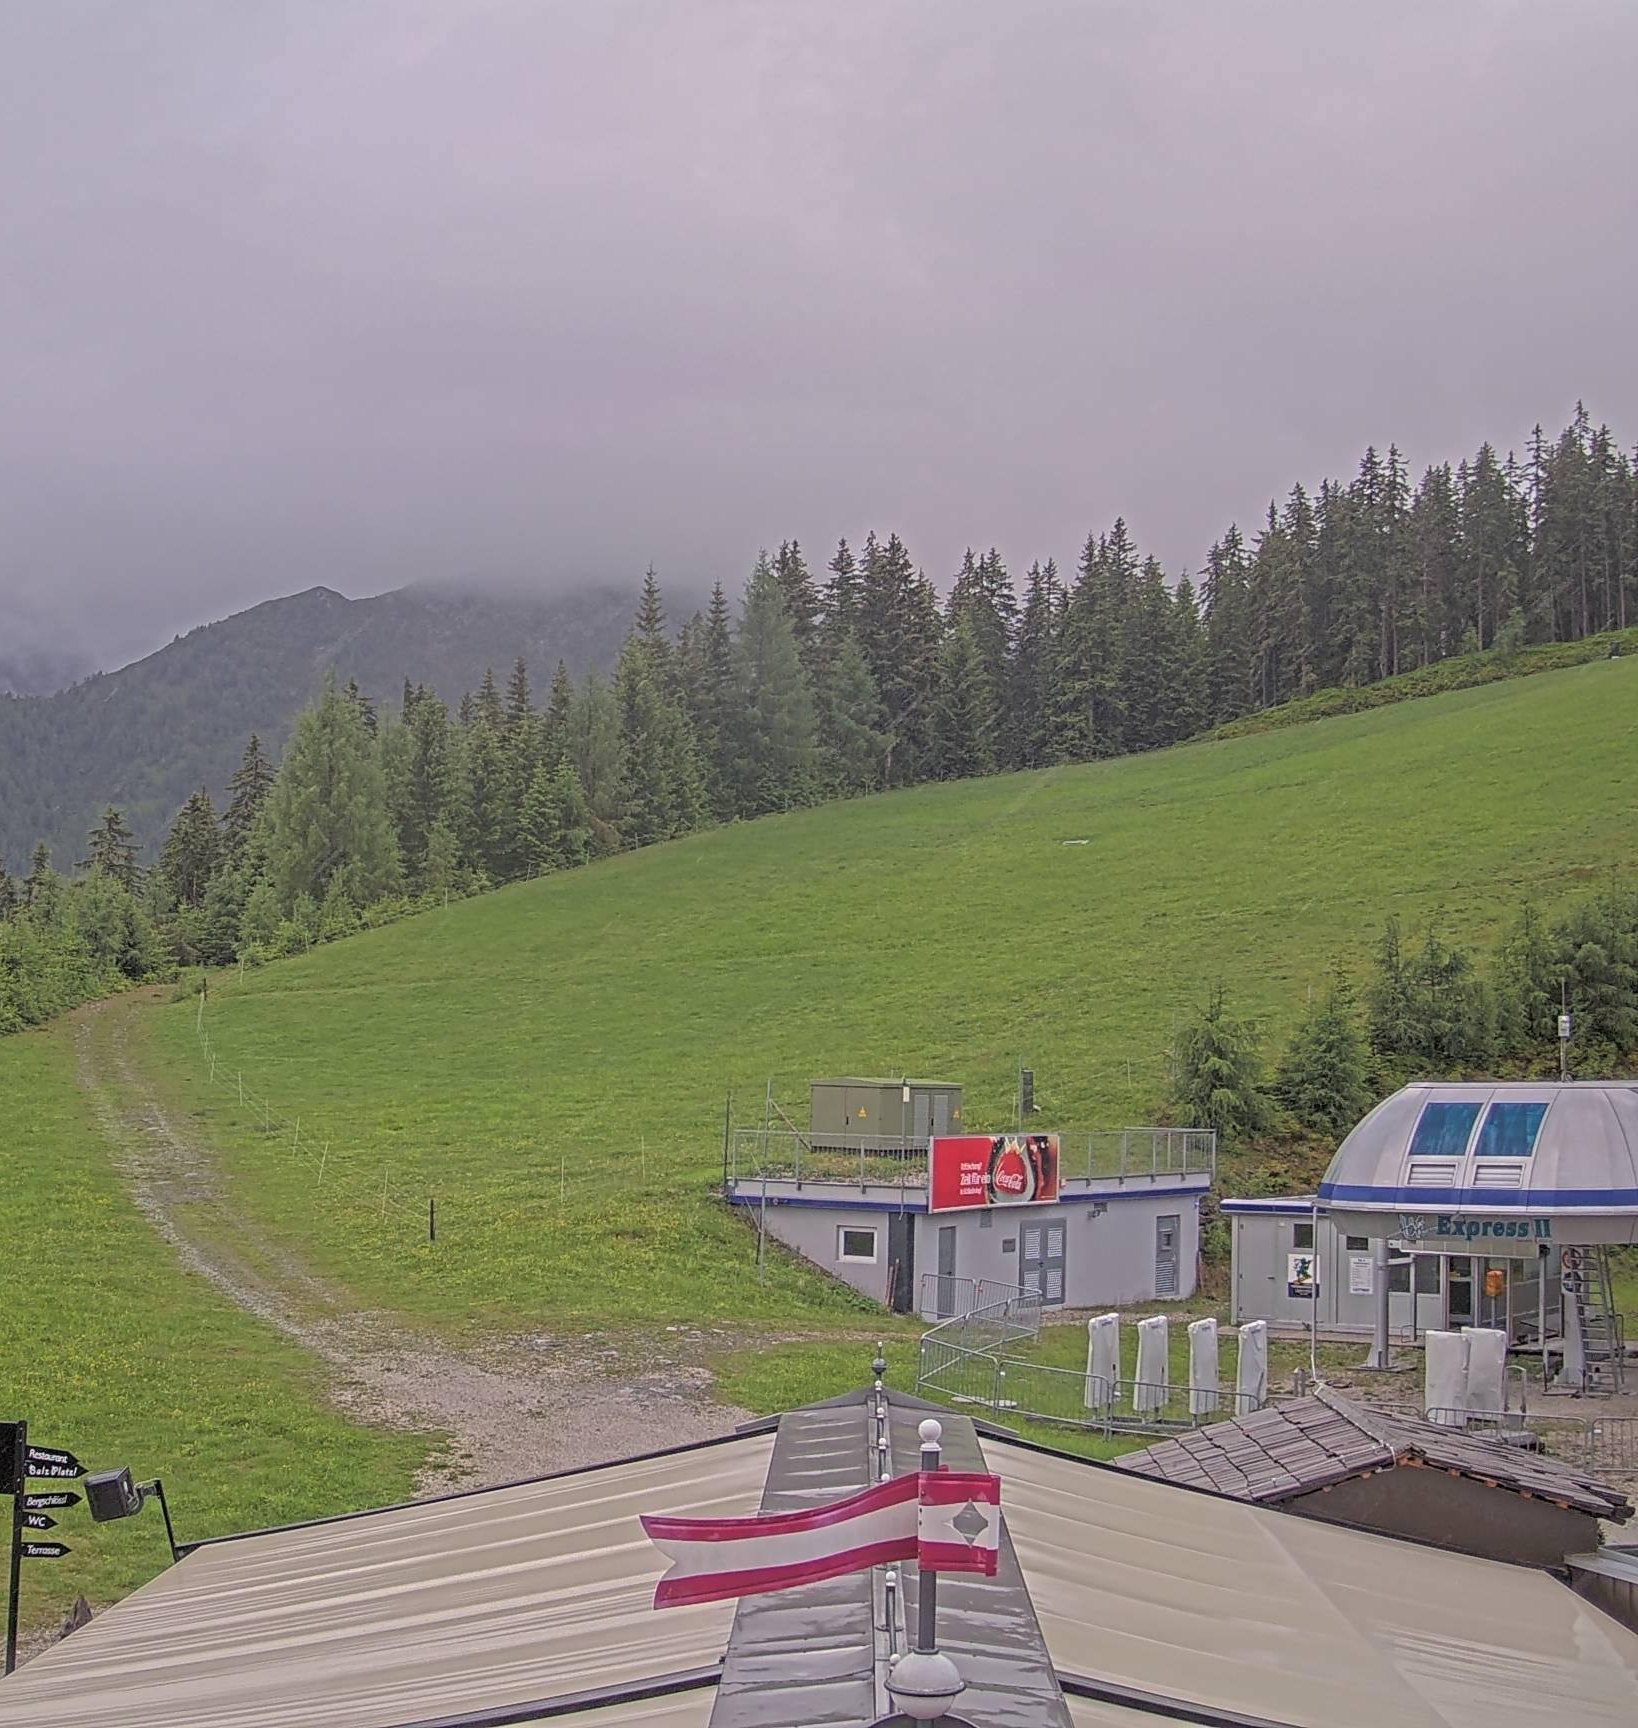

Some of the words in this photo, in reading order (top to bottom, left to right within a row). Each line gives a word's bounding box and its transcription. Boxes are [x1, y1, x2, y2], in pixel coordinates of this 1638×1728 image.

[1437, 1215, 1529, 1241] Express
[28, 1515, 46, 1527] WC
[27, 1545, 61, 1555] Terrasse
